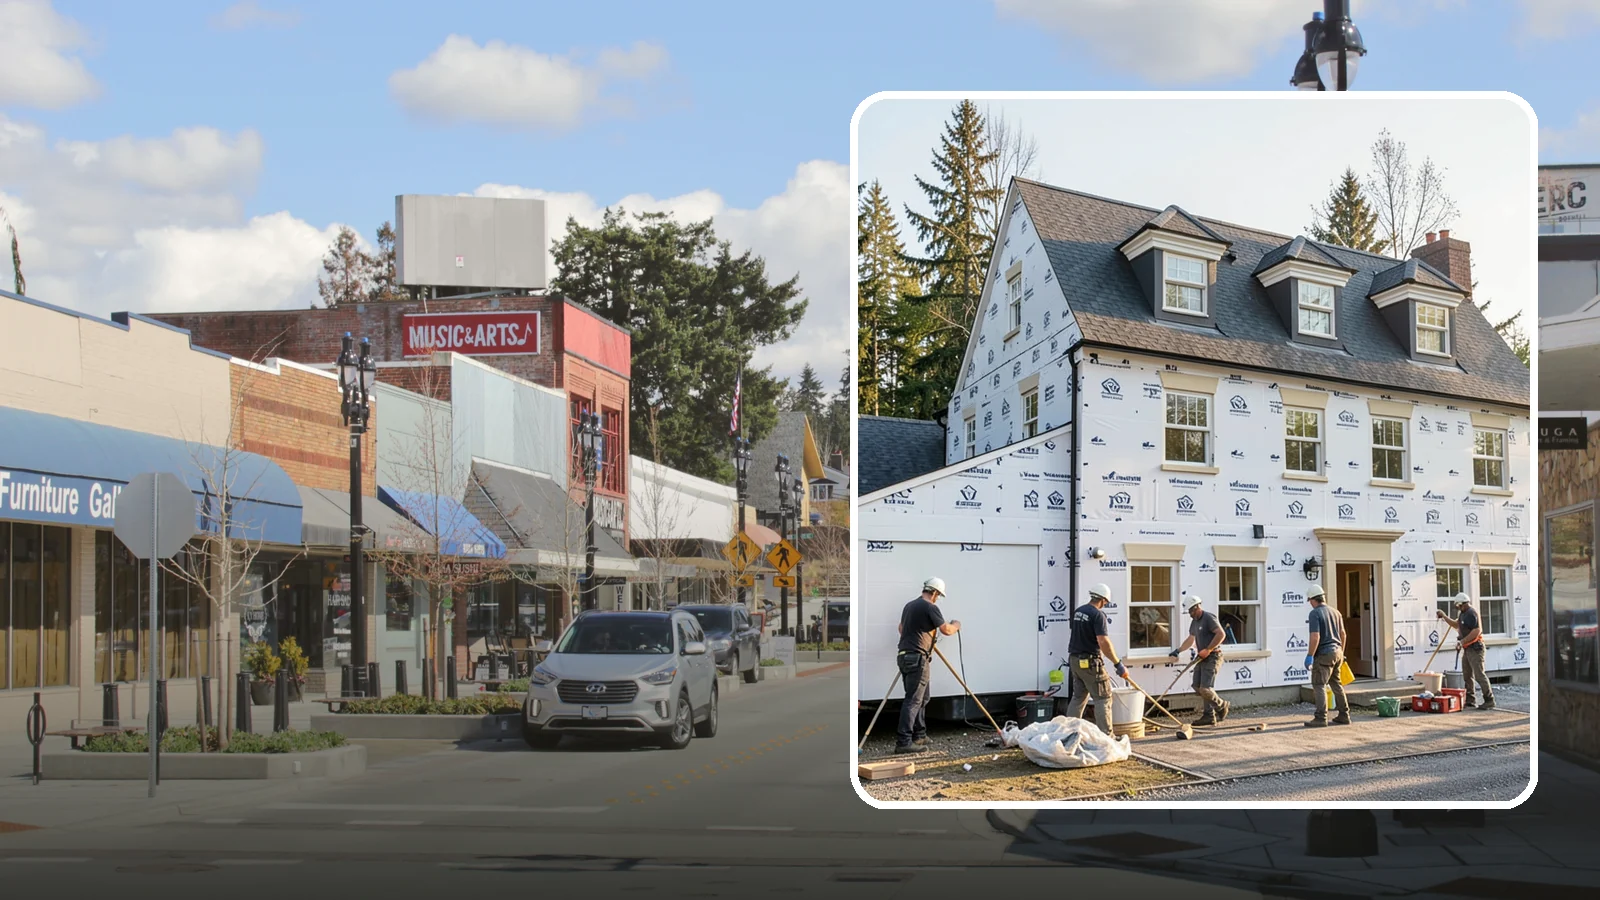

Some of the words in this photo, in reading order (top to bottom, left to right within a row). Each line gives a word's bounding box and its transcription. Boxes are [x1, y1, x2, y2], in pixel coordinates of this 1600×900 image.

[0, 471, 79, 515] Furniture
[90, 482, 121, 518] Gal
[453, 563, 479, 574] SUSHI
